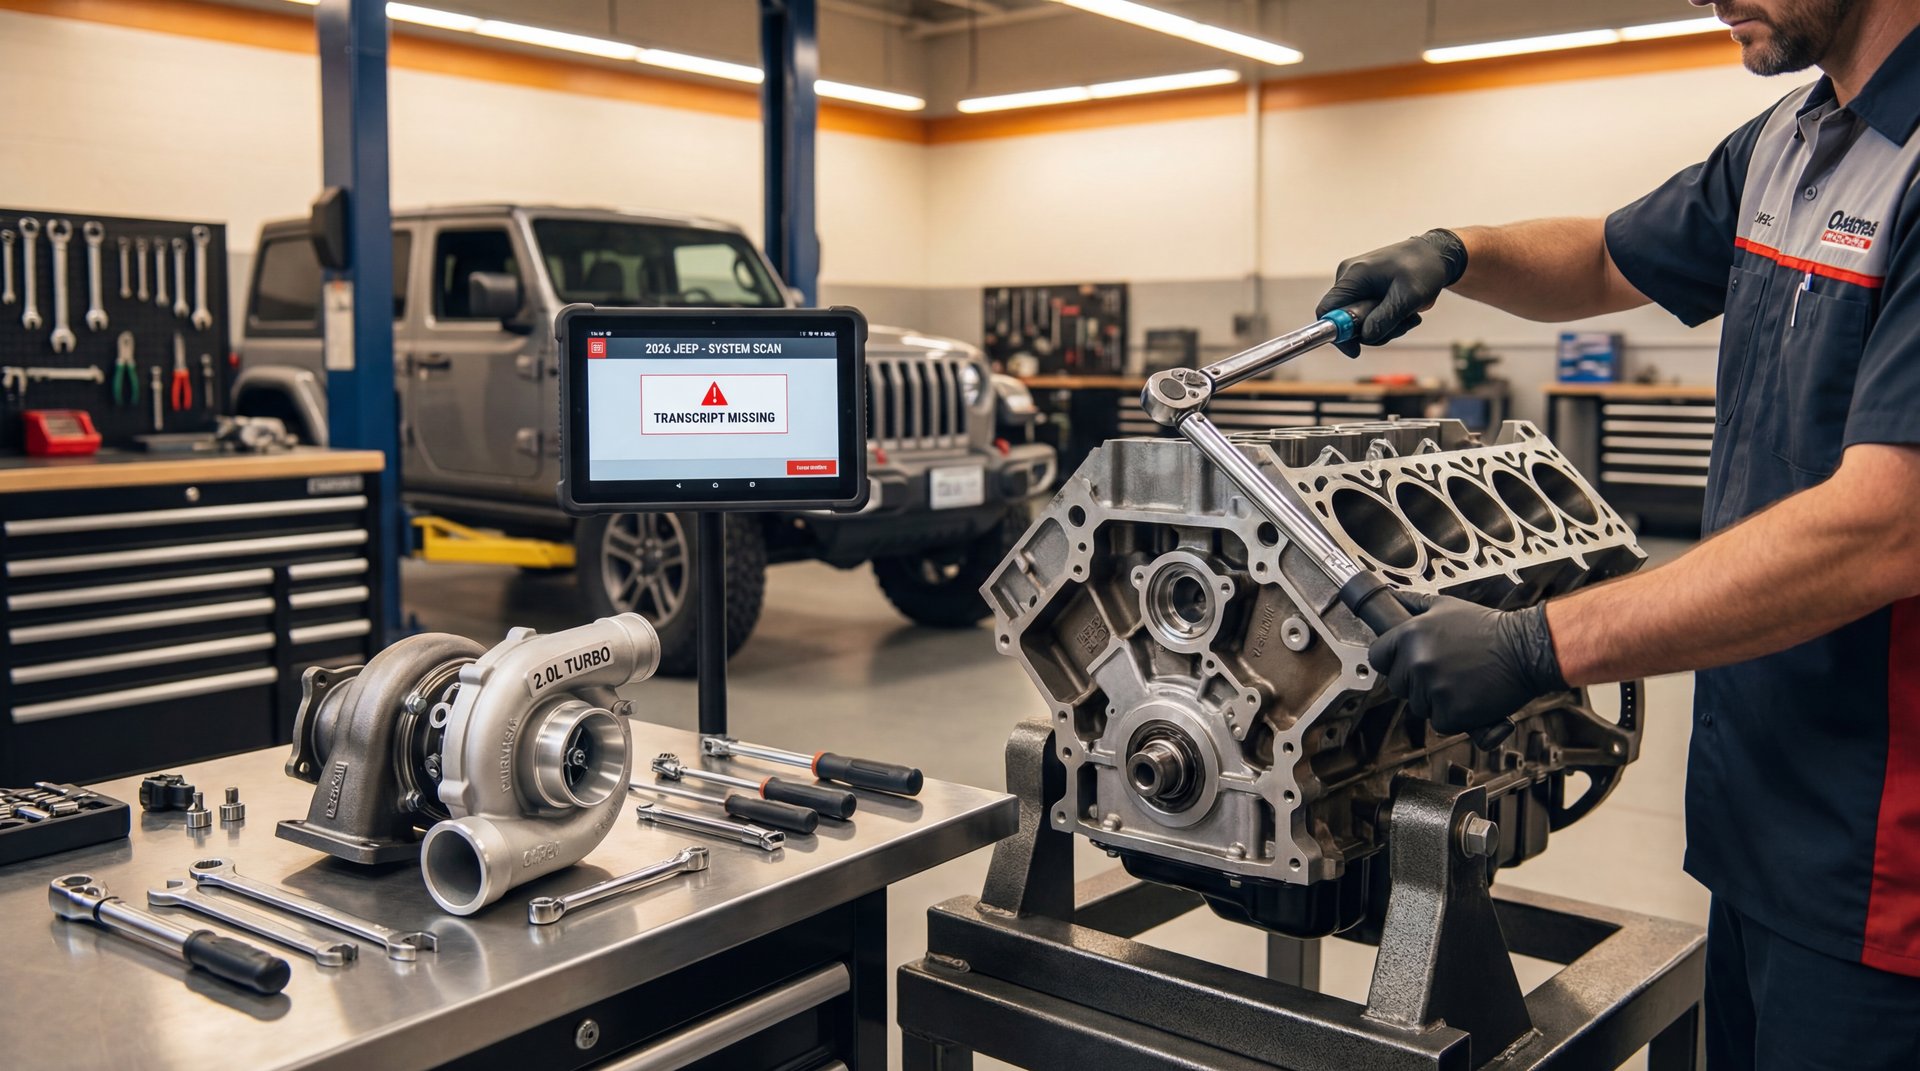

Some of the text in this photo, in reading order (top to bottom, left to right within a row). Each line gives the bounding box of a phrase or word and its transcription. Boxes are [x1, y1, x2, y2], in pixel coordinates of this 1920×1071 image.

[645, 343, 671, 354] 2026
[673, 343, 699, 354] JEEP
[708, 343, 750, 354] SYSTEM
[753, 343, 782, 354] SCAN
[654, 412, 775, 423] TRANSCRIPT MISSING
[533, 646, 610, 690] 2.0L TURBO
